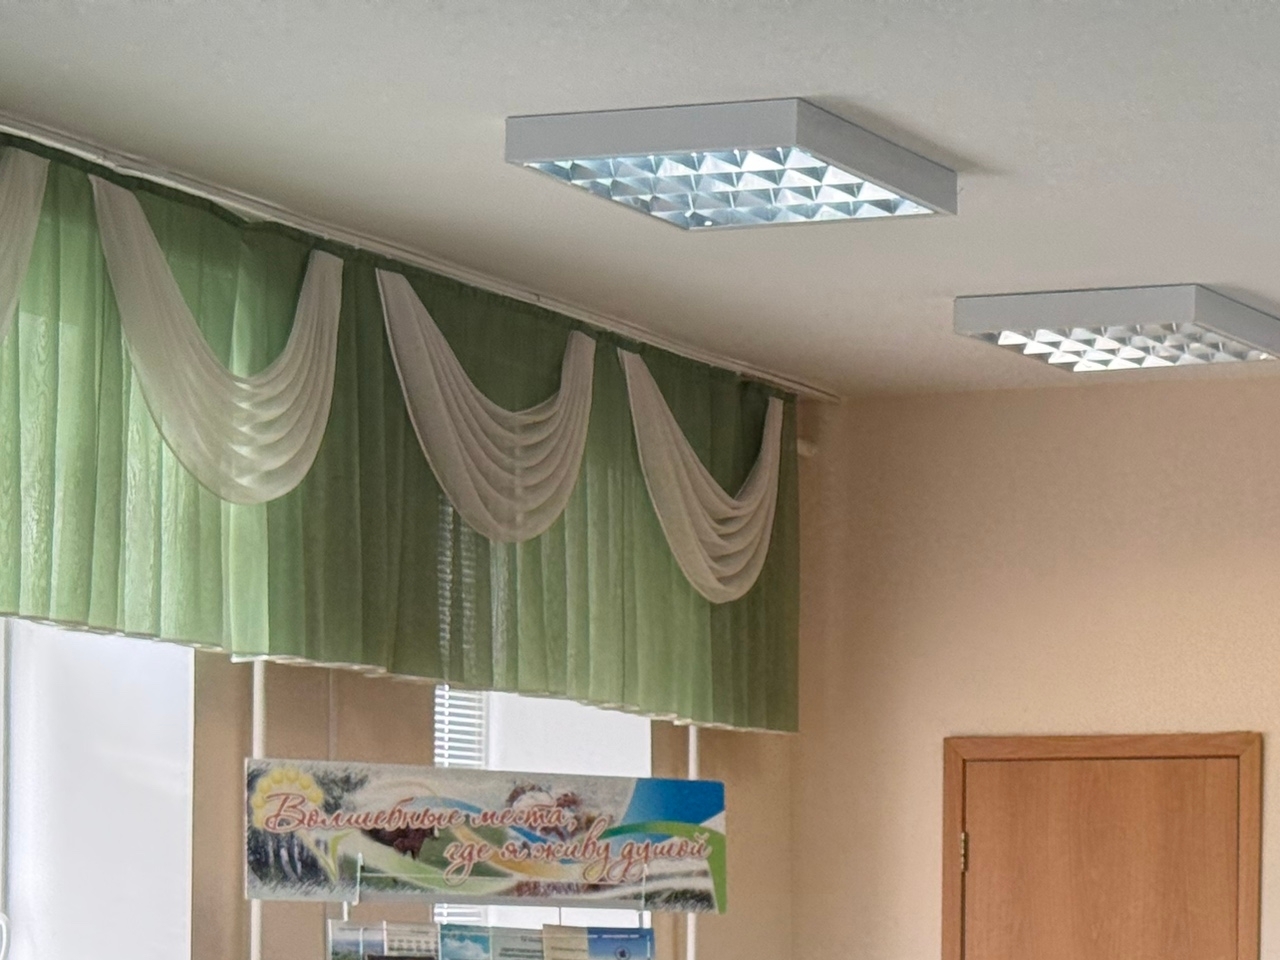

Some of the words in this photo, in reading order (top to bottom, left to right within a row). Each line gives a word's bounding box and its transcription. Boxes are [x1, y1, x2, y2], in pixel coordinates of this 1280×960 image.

[264, 792, 464, 833] Волшебные
[470, 804, 578, 831] места,
[443, 840, 491, 886] где
[500, 841, 528, 862] я
[529, 817, 611, 882] живу
[605, 832, 711, 883] душой
